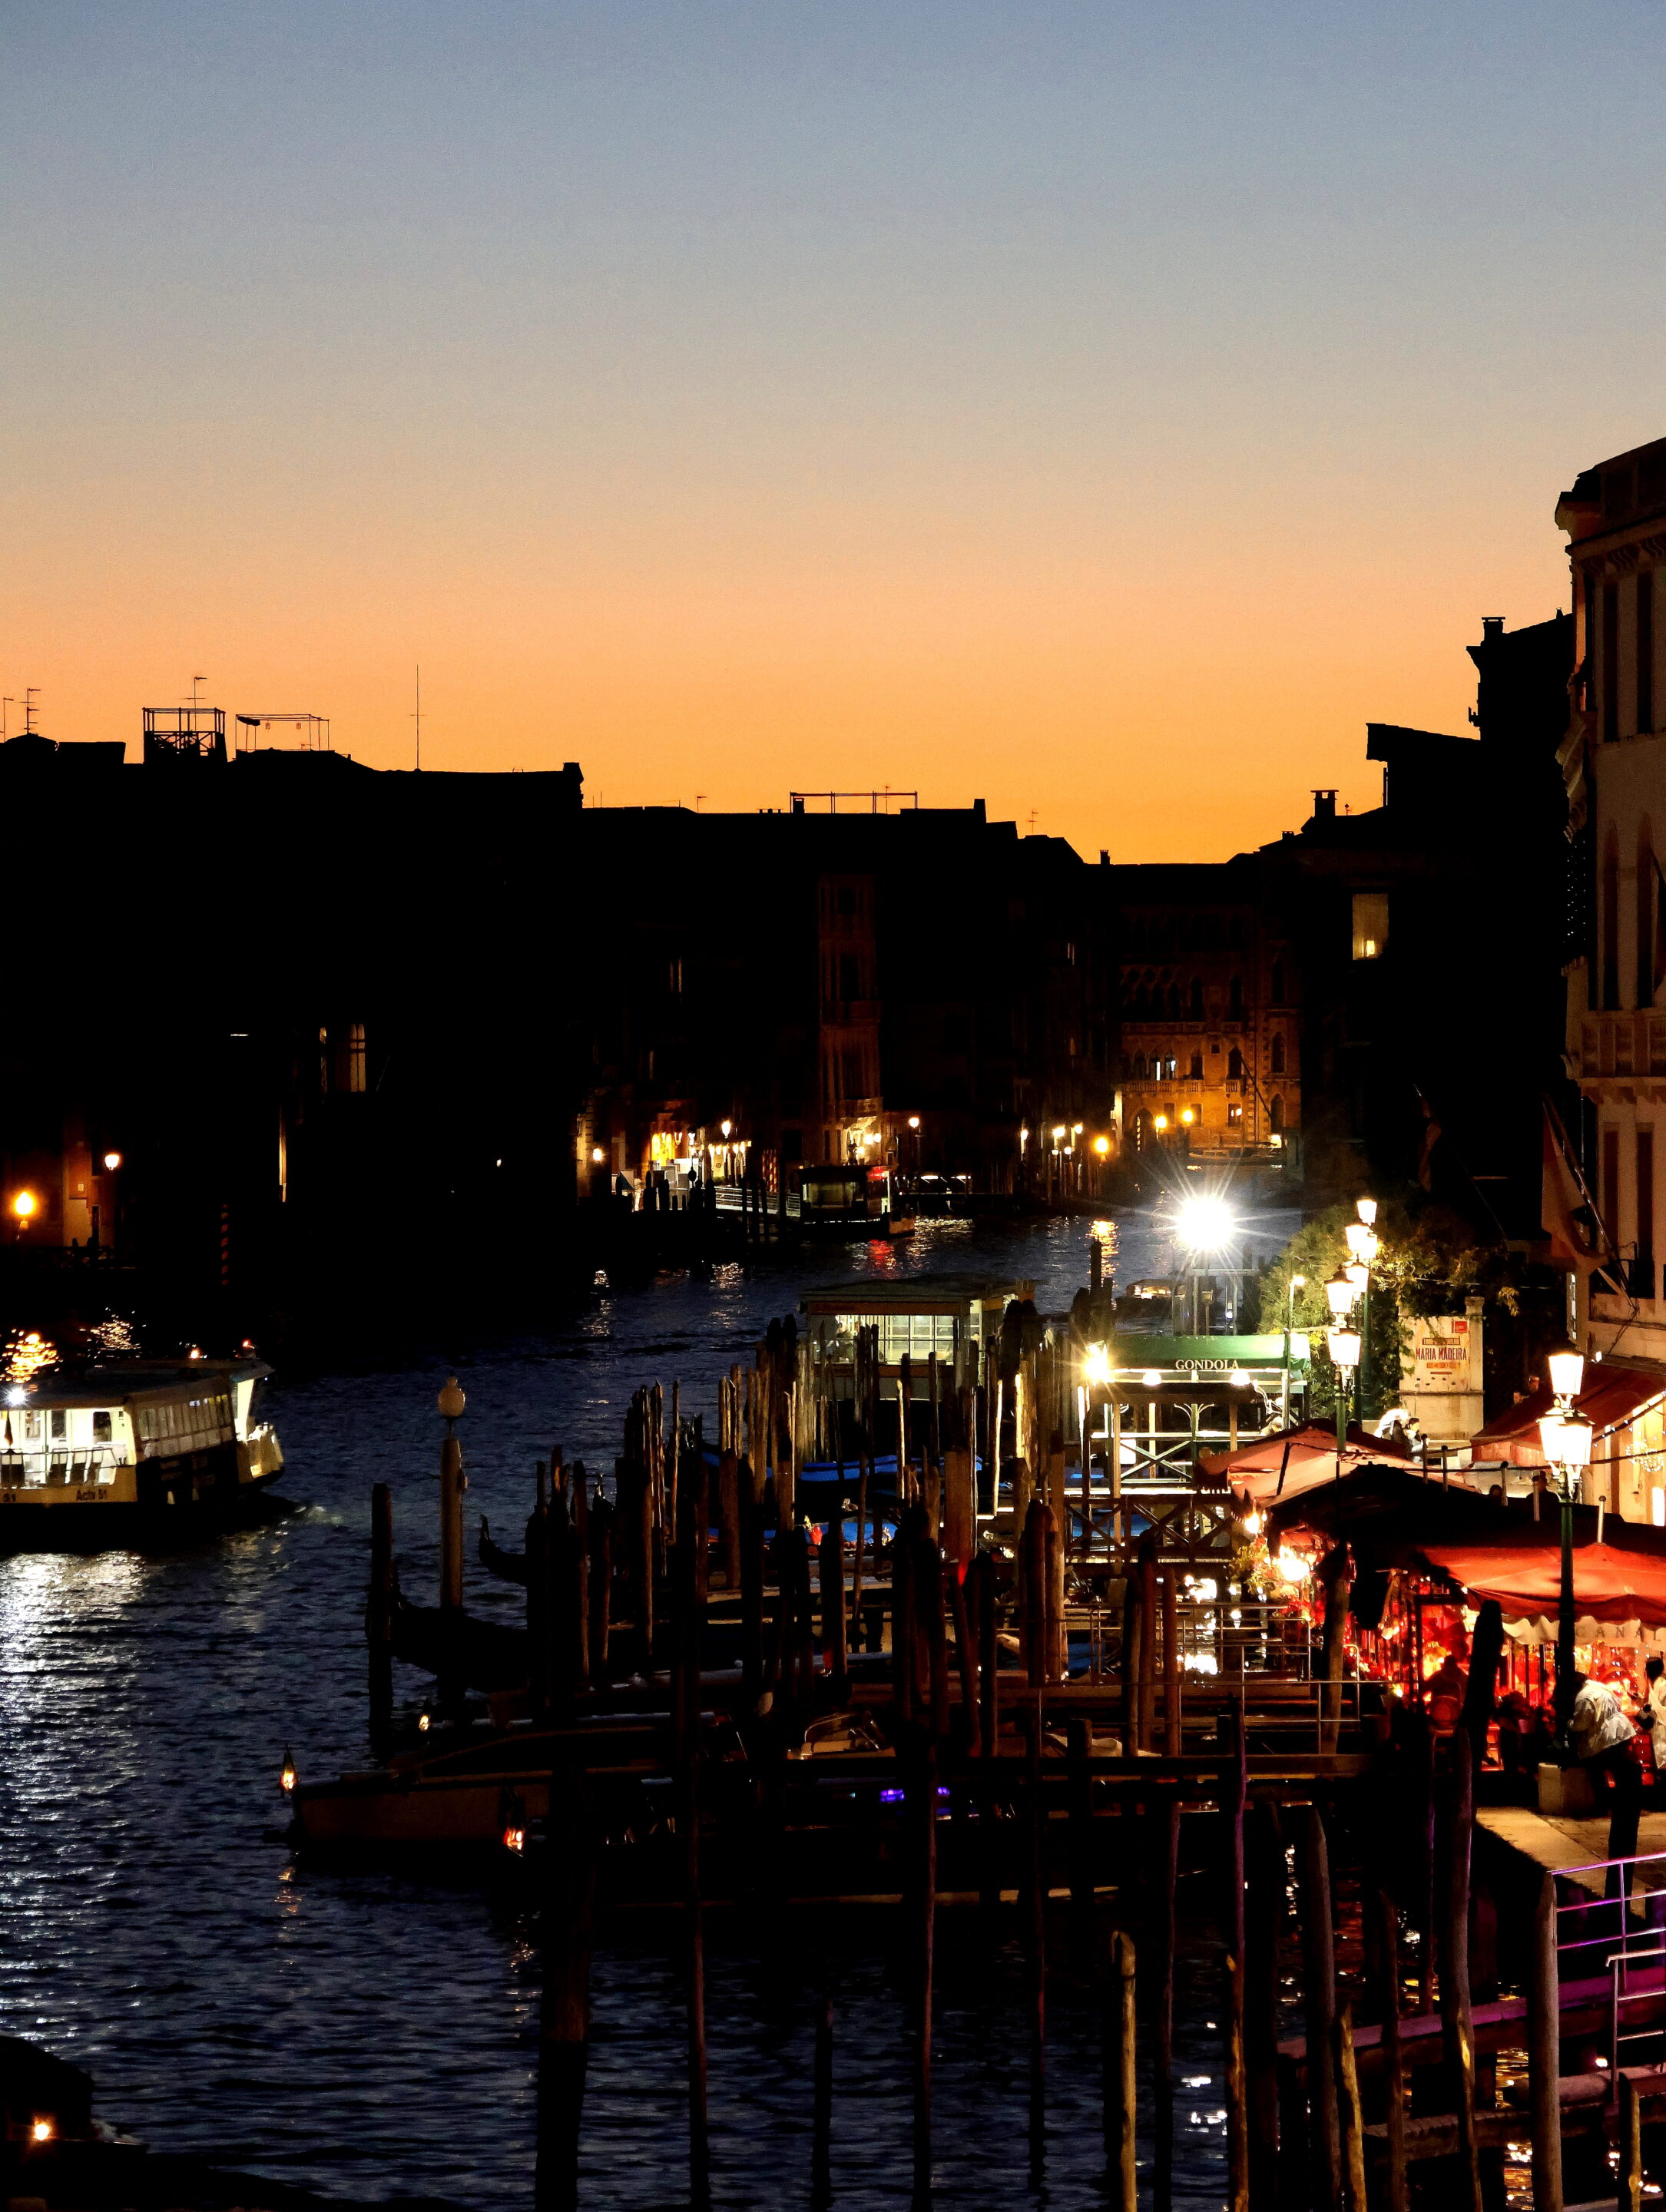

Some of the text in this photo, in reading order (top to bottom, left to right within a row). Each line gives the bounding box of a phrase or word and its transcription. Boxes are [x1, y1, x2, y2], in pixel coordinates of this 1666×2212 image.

[1416, 1347, 1467, 1360] MARIA MADEIRA
[1175, 1359, 1239, 1370] GONDOLA
